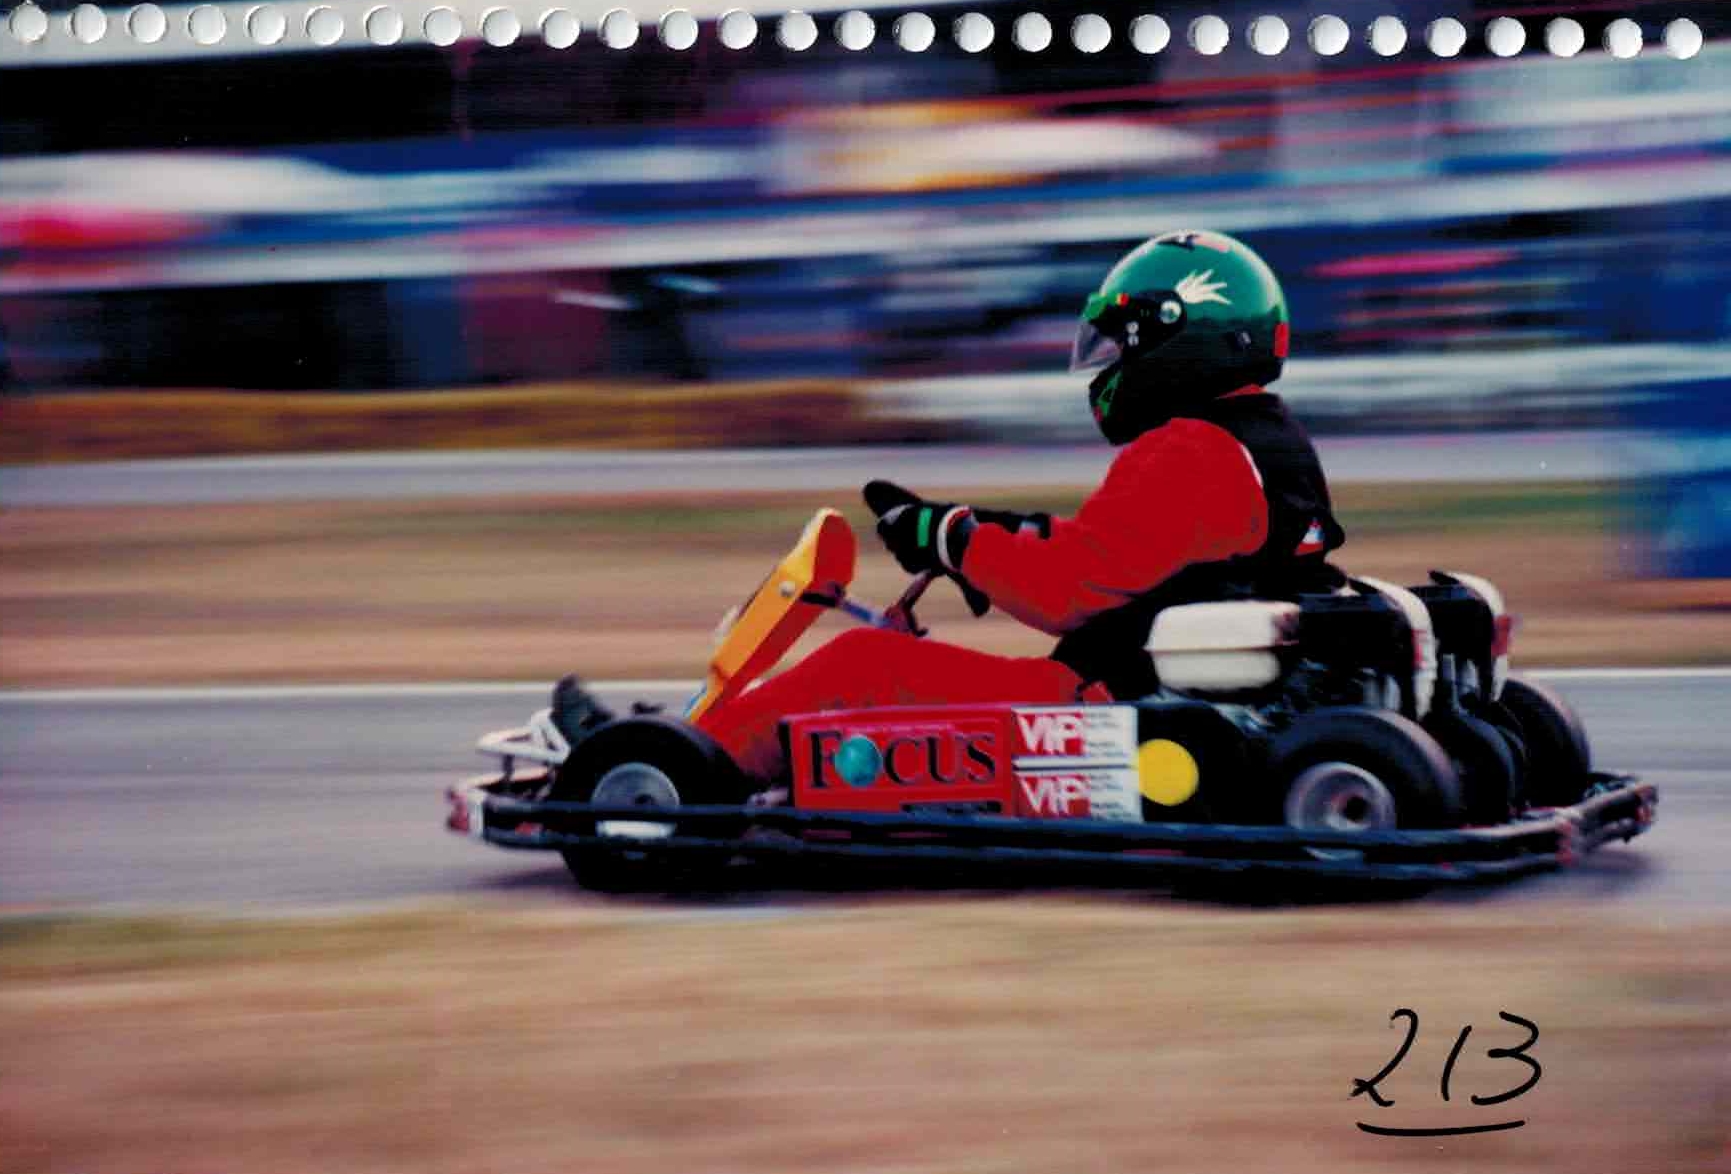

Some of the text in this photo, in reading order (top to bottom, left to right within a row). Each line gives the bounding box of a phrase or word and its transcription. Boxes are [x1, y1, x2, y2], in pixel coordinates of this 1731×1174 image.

[1016, 713, 1083, 753] VIP
[806, 728, 997, 789] FOCUS
[1020, 775, 1089, 815] VIP
[1351, 1008, 1542, 1107] 213
